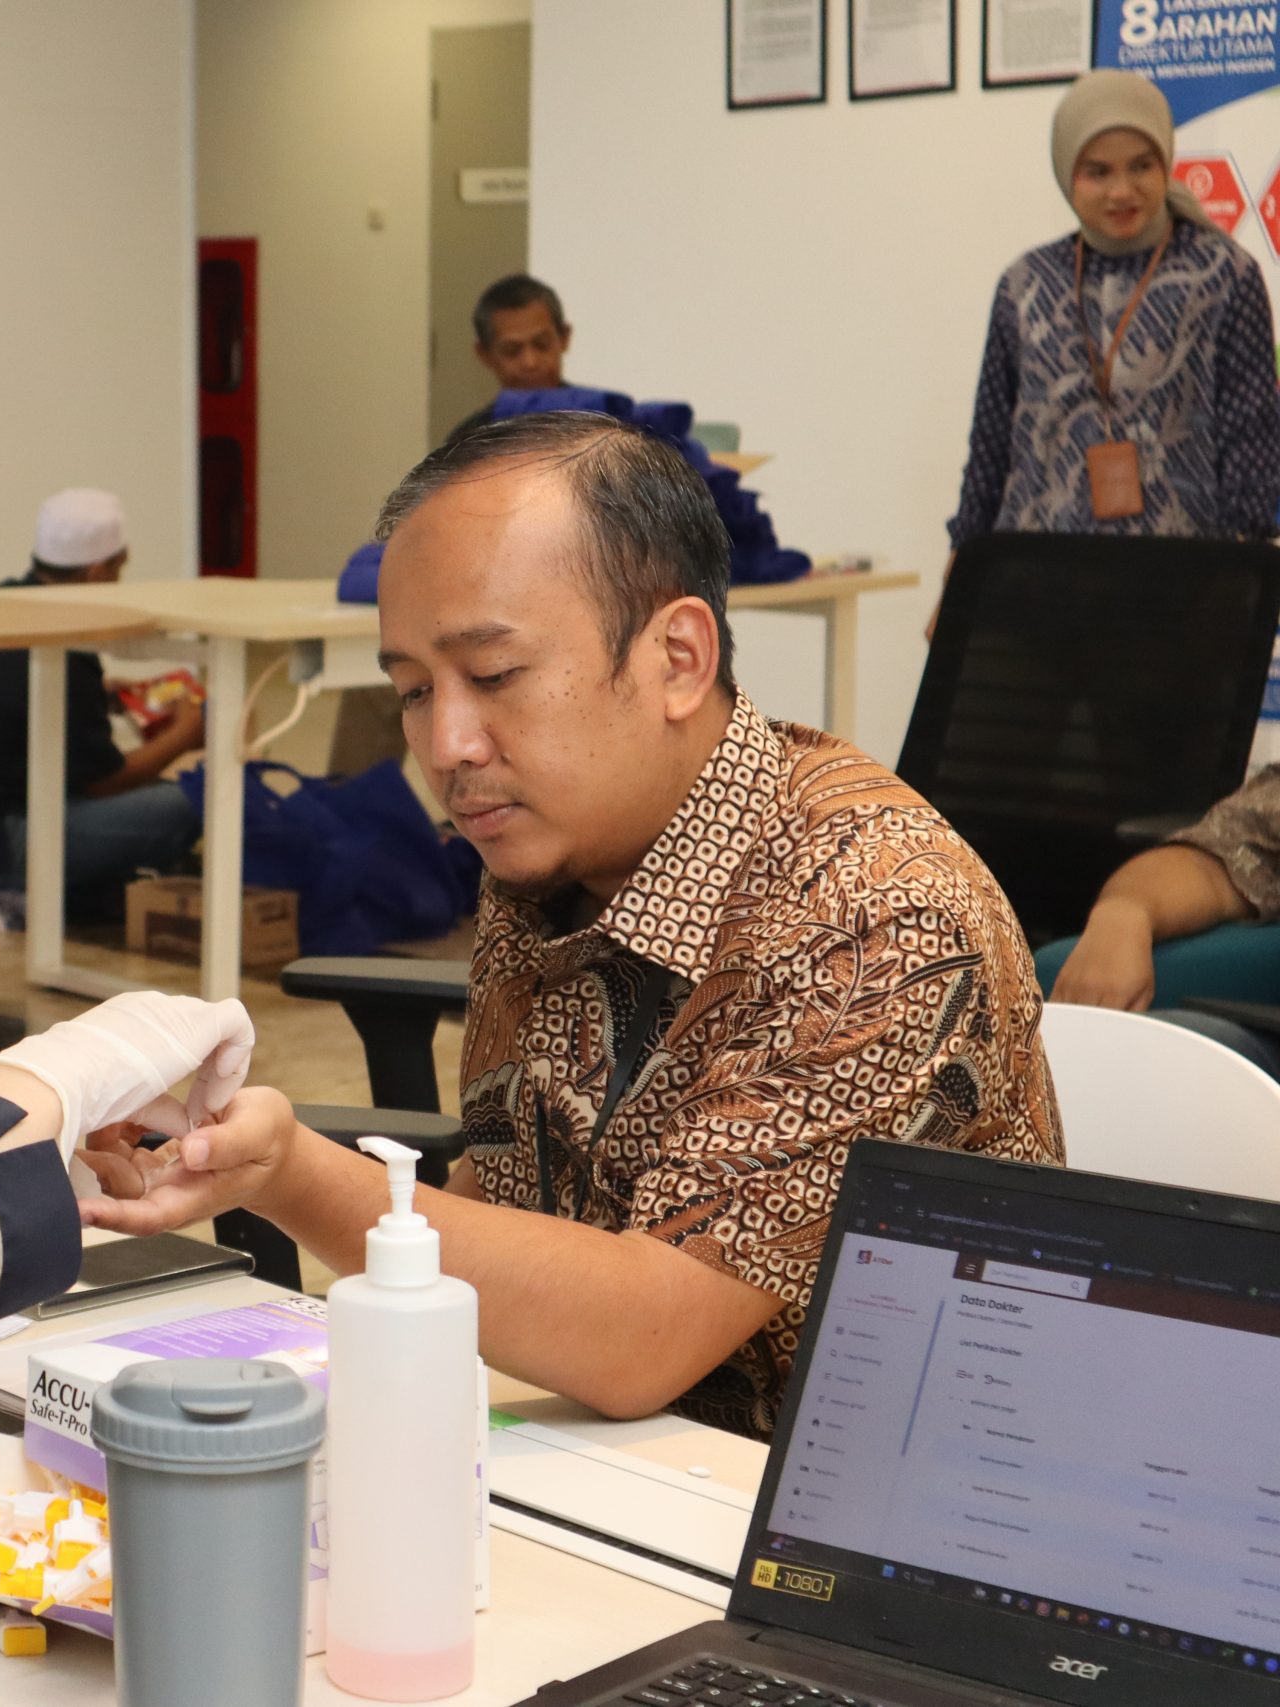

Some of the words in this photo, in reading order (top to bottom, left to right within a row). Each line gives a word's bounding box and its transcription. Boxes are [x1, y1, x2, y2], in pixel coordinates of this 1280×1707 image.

[1120, 0, 1159, 47] 8
[1158, 7, 1277, 41] ARAHAN
[1208, 34, 1275, 58] UTAMA
[960, 1294, 986, 1307] Data
[988, 1299, 1024, 1314] Dokter
[32, 1369, 91, 1412] ACCU-
[30, 1398, 88, 1436] Safe-T-Pro
[757, 1571, 772, 1583] HD
[784, 1571, 823, 1594] 1080
[1048, 1655, 1109, 1680] acer
